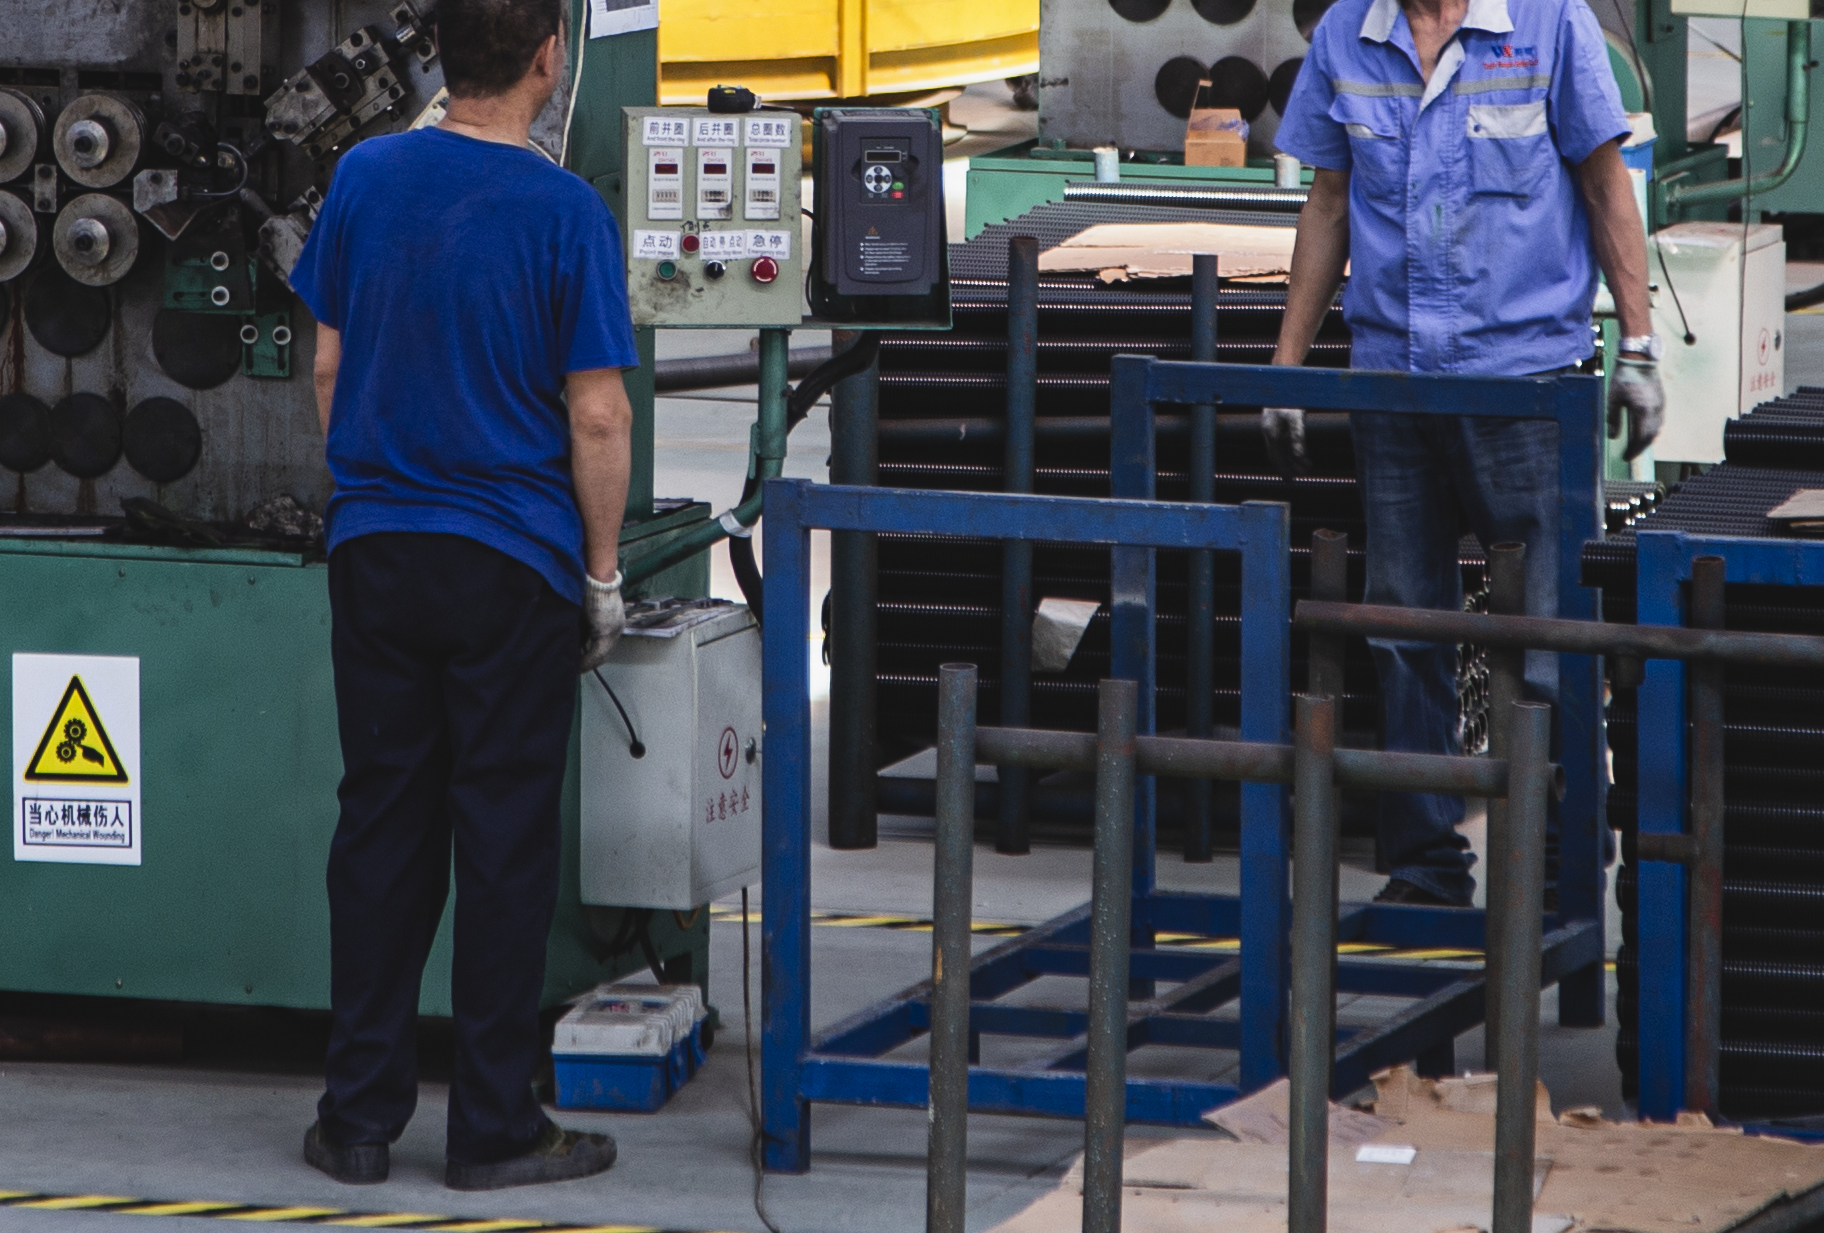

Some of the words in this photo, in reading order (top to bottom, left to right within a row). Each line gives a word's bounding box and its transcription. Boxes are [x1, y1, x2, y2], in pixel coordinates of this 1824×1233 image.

[751, 122, 787, 136] 总圈数
[642, 234, 673, 249] 点动
[752, 234, 783, 249] 急停
[705, 785, 751, 824] 注意安全
[29, 802, 125, 828] 当心机械伤人
[55, 829, 91, 839] Mechanical
[93, 830, 125, 844] Wounding
